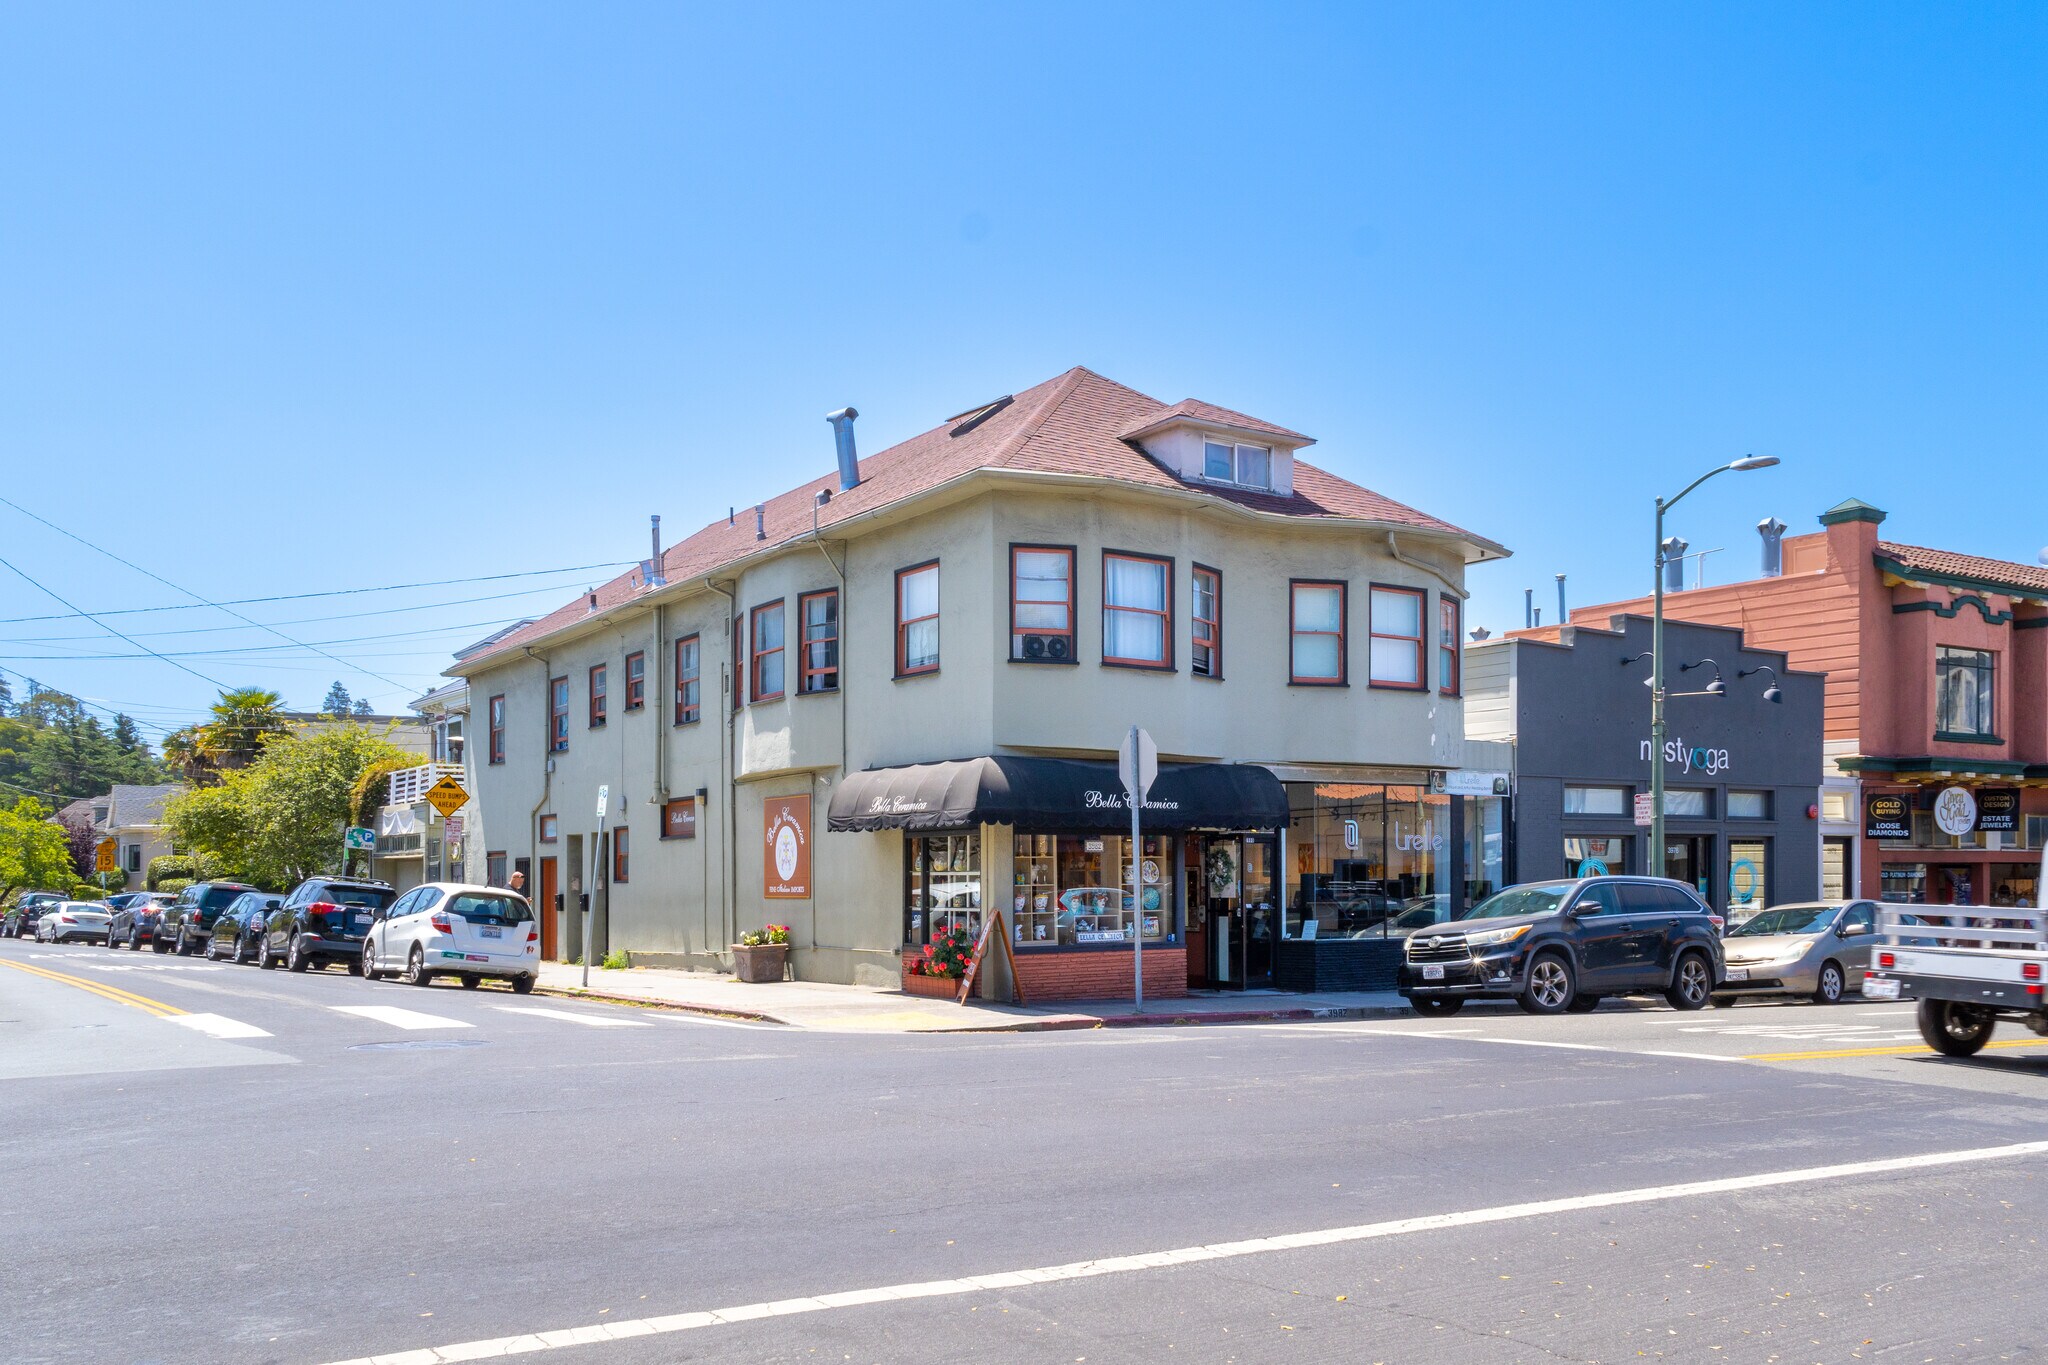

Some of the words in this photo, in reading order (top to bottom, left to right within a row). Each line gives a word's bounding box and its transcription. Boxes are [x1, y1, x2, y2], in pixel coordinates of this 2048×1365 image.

[1640, 737, 1730, 776] nstyoga
[437, 801, 457, 809] AHEAD
[893, 795, 928, 813] Ceramica
[1084, 790, 1122, 808] Bella
[1122, 791, 1179, 809] Camica
[782, 806, 805, 845] Ceramica
[1868, 829, 1909, 837] DIAMONDS
[1395, 819, 1443, 851] Lirelle
[100, 856, 111, 865] 15
